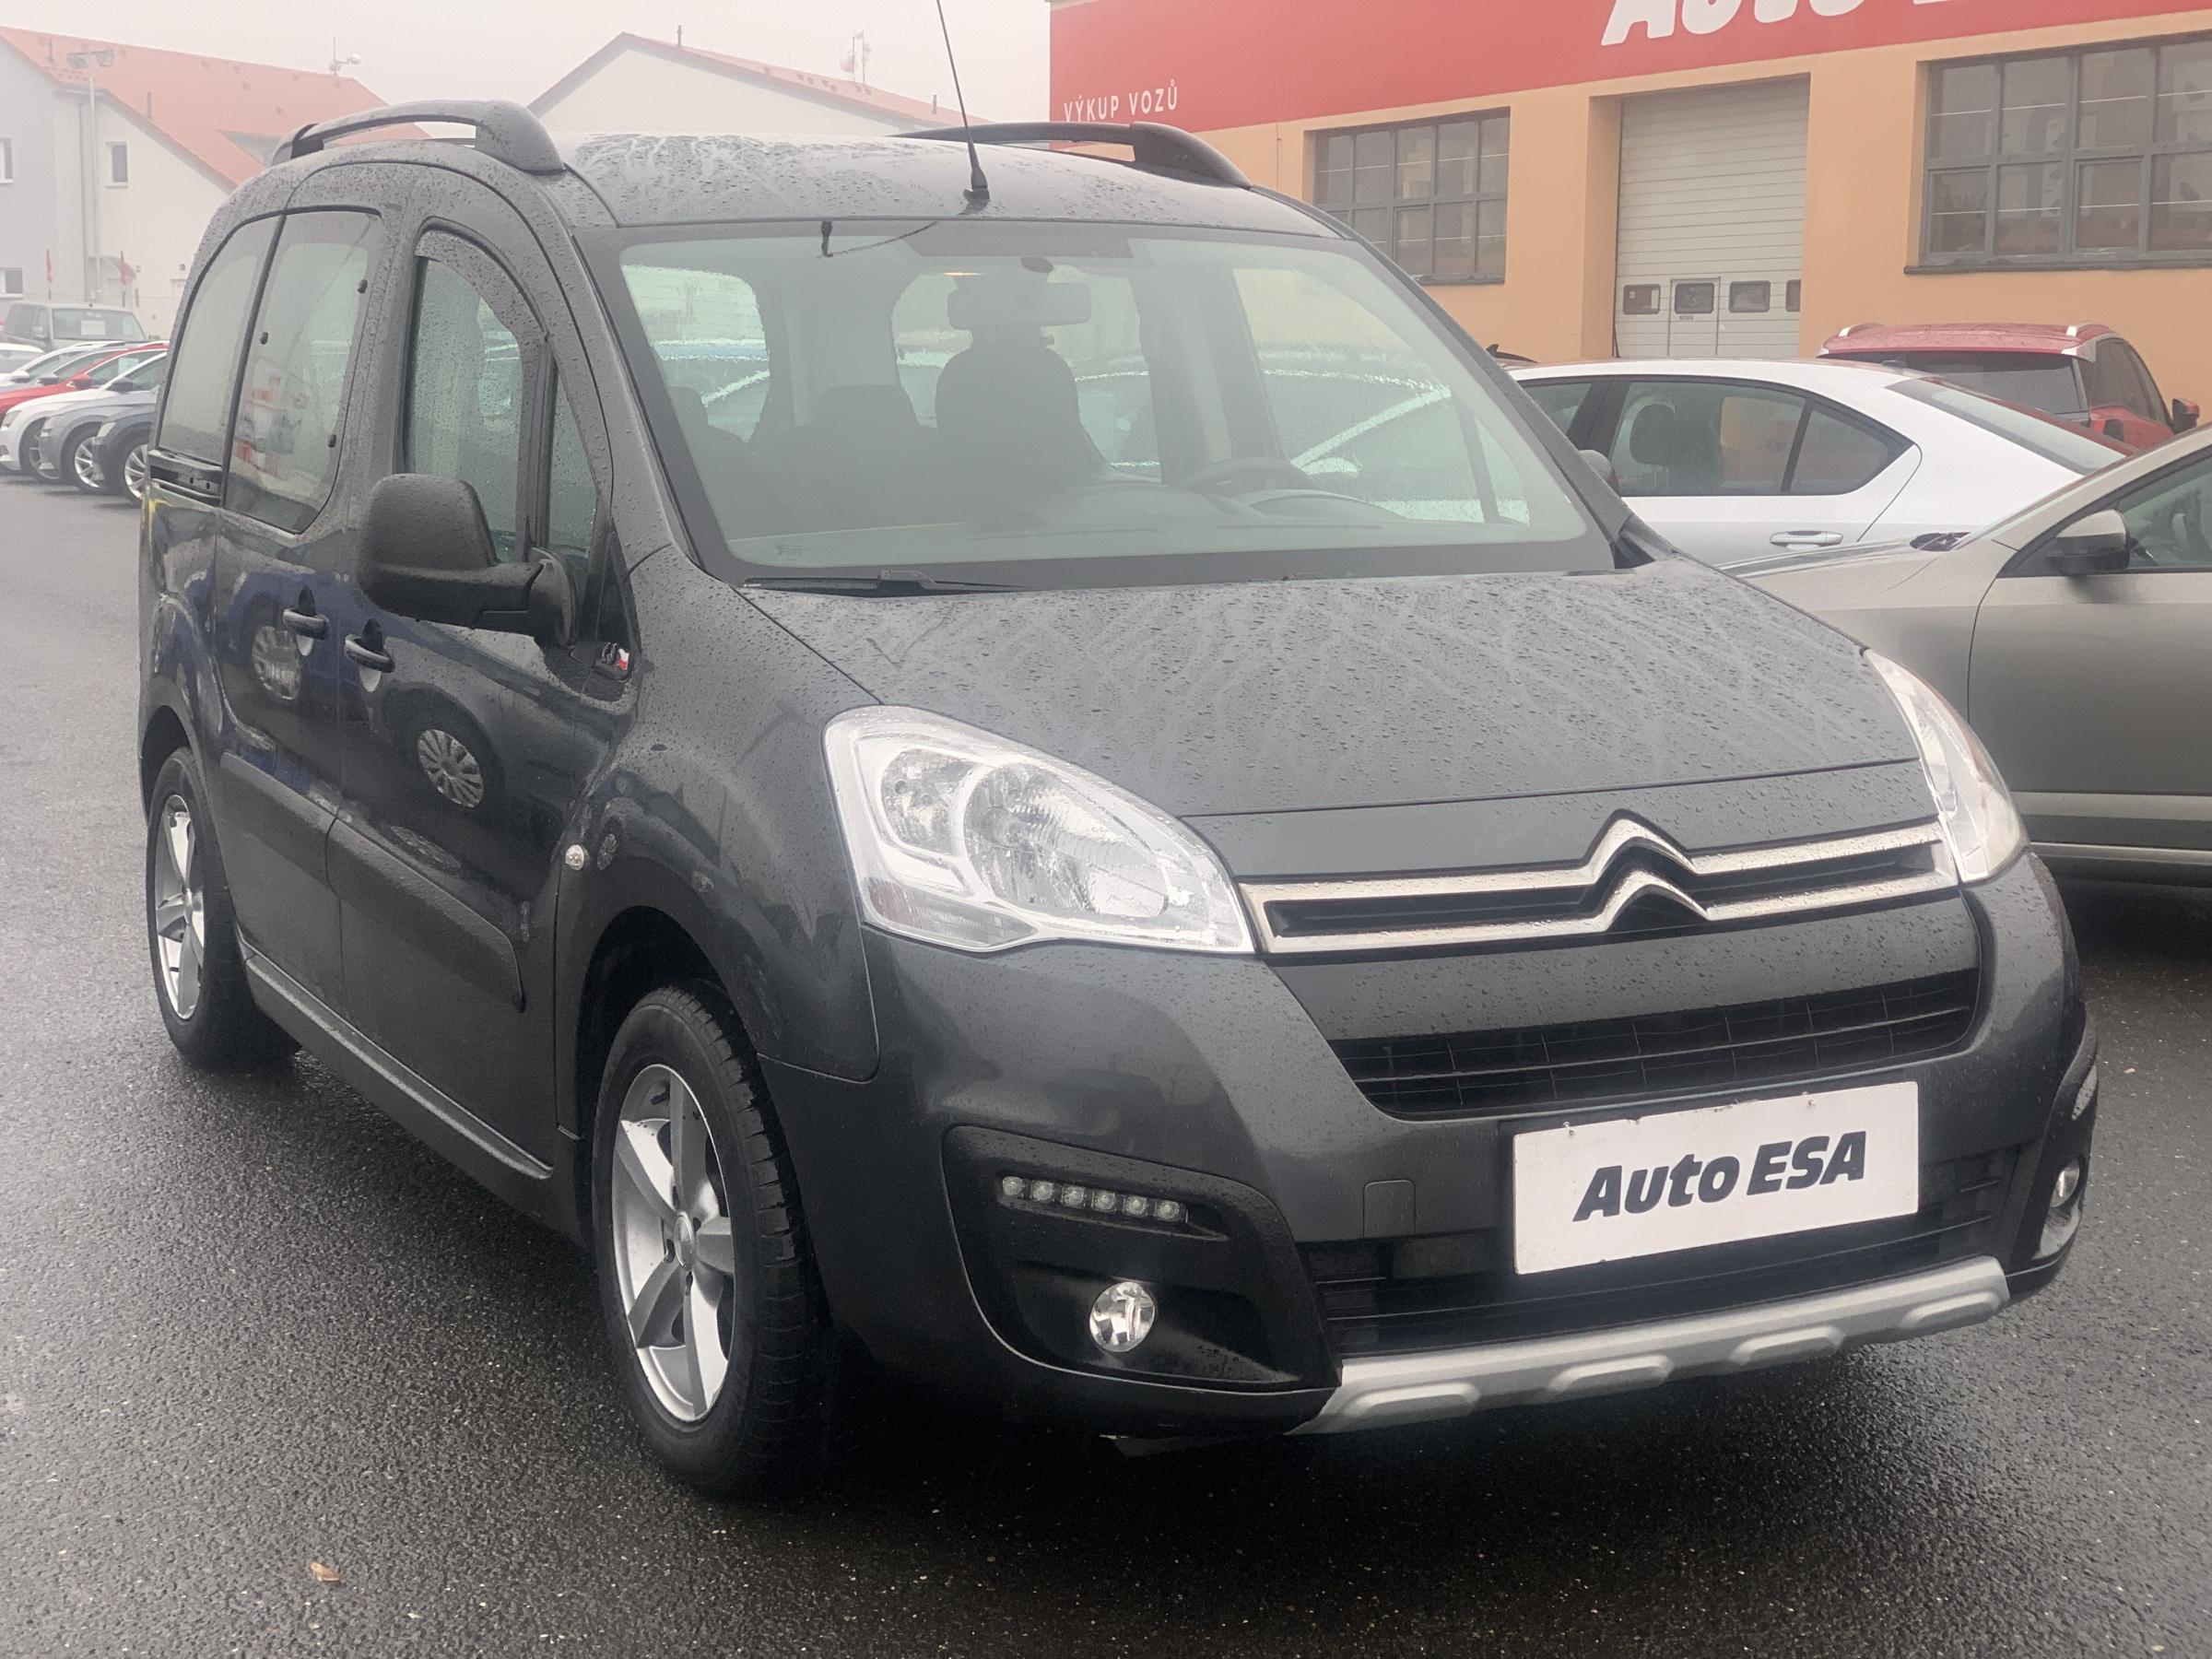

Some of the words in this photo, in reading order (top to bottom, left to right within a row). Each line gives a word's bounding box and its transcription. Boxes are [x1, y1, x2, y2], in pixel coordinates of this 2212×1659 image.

[1064, 94, 1119, 123] VÝKUP
[1128, 78, 1178, 116] VOZŮ
[1572, 1154, 1740, 1222] Auto
[1746, 1130, 1866, 1196] ESA
